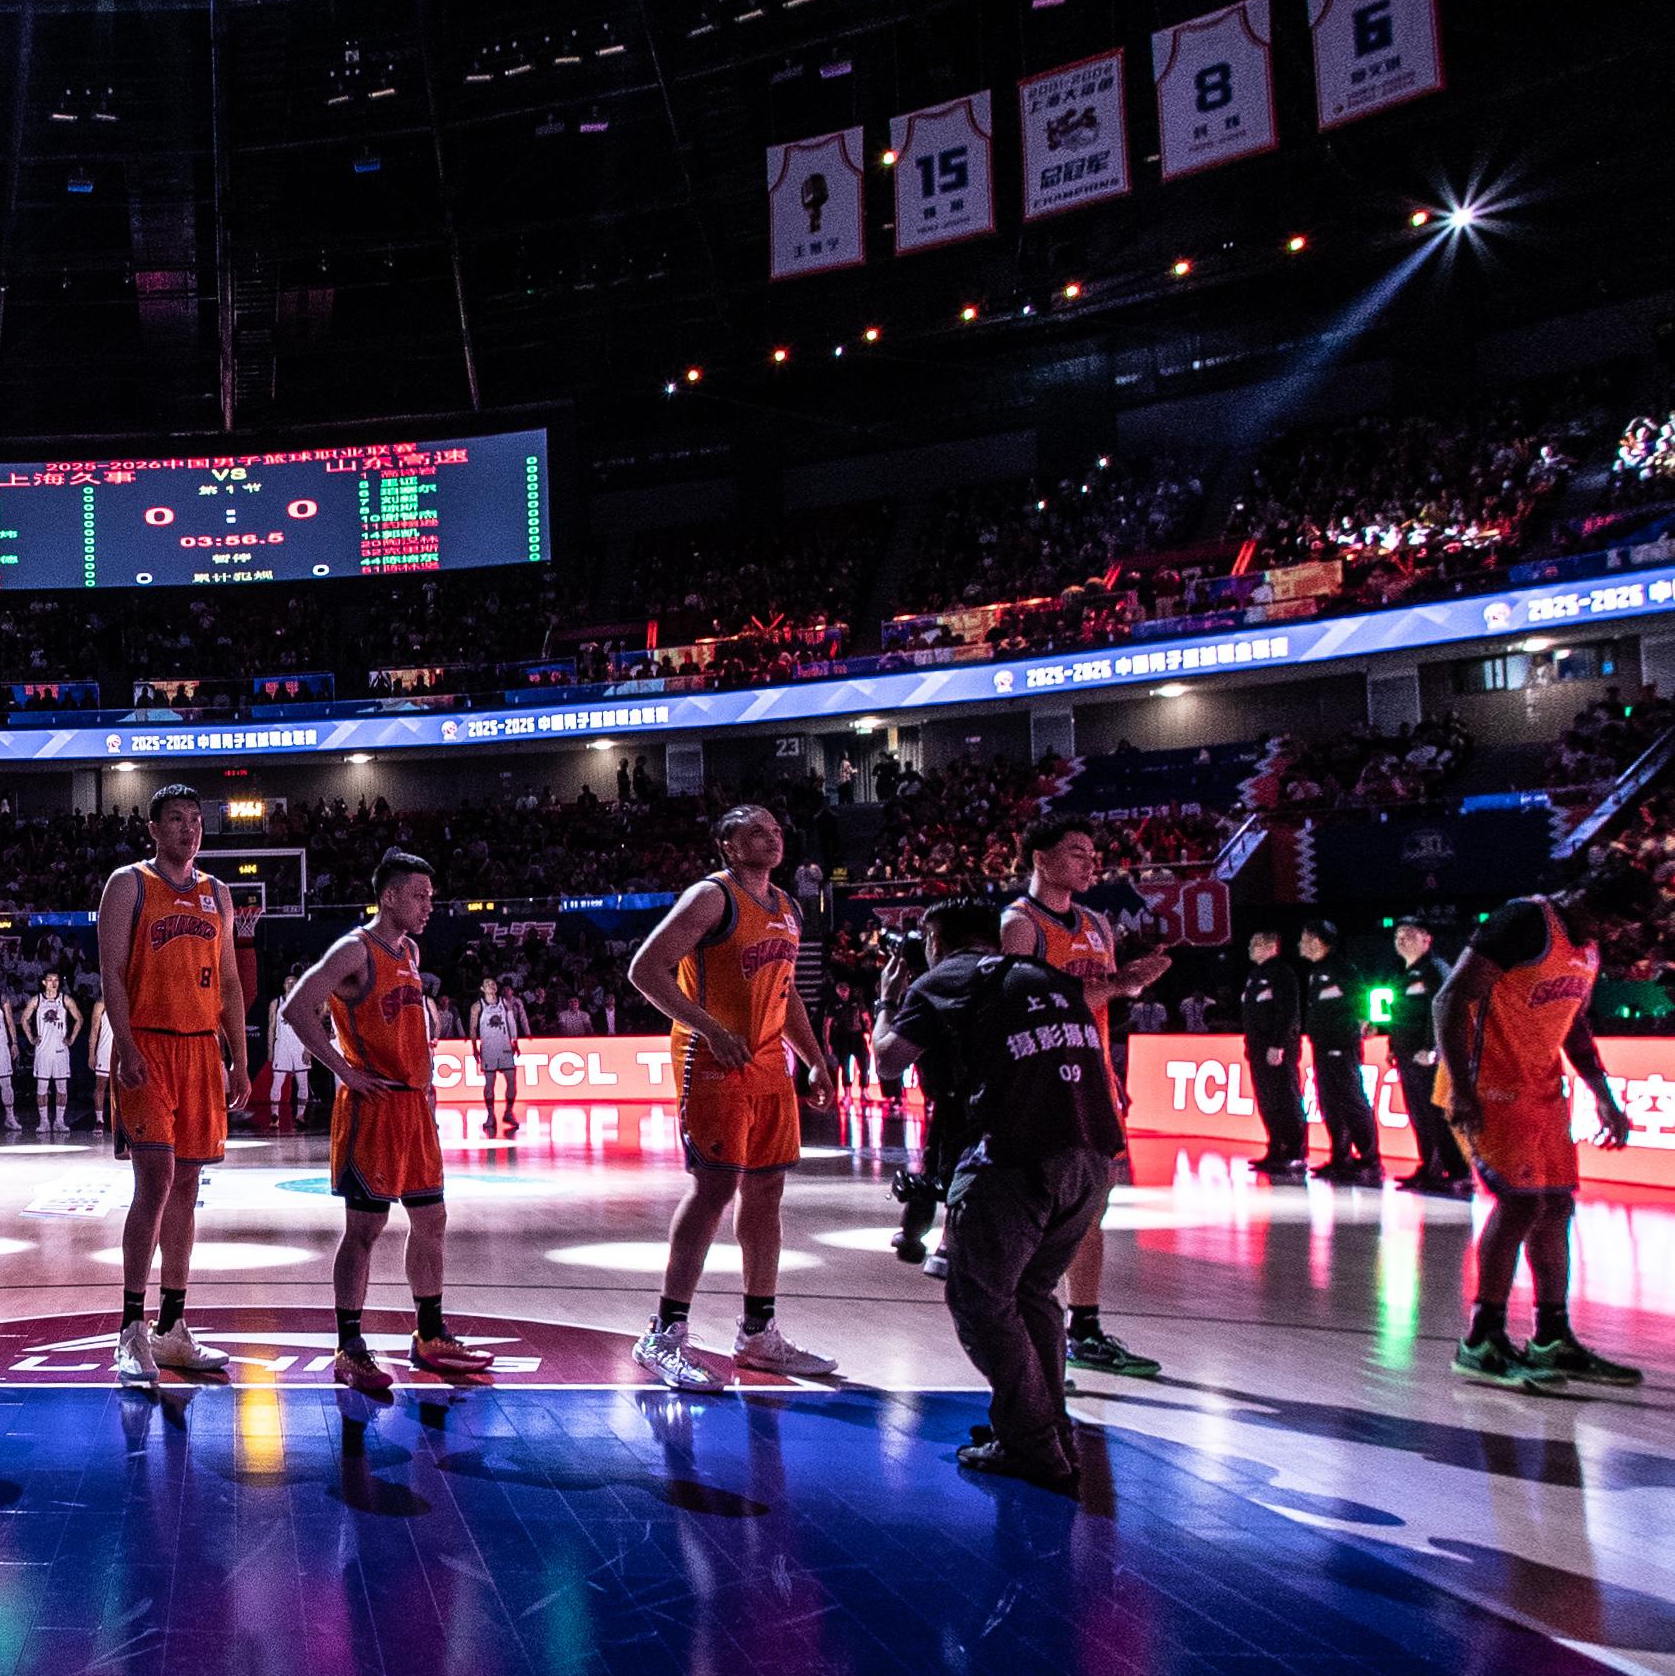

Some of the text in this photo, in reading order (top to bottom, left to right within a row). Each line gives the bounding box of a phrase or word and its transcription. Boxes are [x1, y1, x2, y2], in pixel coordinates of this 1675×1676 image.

[1195, 62, 1232, 113] 8
[915, 145, 968, 199] 15
[526, 457, 537, 465] 0
[527, 465, 537, 473] 0
[211, 468, 247, 481] VS
[527, 474, 538, 482] 0
[527, 483, 538, 491] 0
[83, 495, 94, 503] 0
[527, 492, 538, 500] 0
[528, 500, 539, 508] 0
[84, 512, 95, 520] 0
[144, 499, 318, 526] 0 0
[528, 509, 539, 517] 0
[528, 518, 539, 526] 0
[529, 526, 539, 534] 0
[84, 537, 95, 545] 0
[180, 532, 284, 548] 03:56.5
[529, 535, 540, 543] 0
[529, 544, 540, 552] 0
[84, 554, 95, 562] 0
[529, 553, 540, 561] 0
[312, 564, 330, 576] 0
[85, 571, 96, 579] 0
[136, 572, 153, 585] 0
[1026, 659, 1112, 688] 2025-2026
[468, 717, 535, 738] 2025-2026
[131, 734, 194, 751] 2025-2026
[200, 967, 212, 988] 8
[433, 1054, 486, 1087] CL
[515, 1052, 618, 1086] TCL
[1059, 1065, 1081, 1082] 09
[1166, 1060, 1254, 1115] TCL
